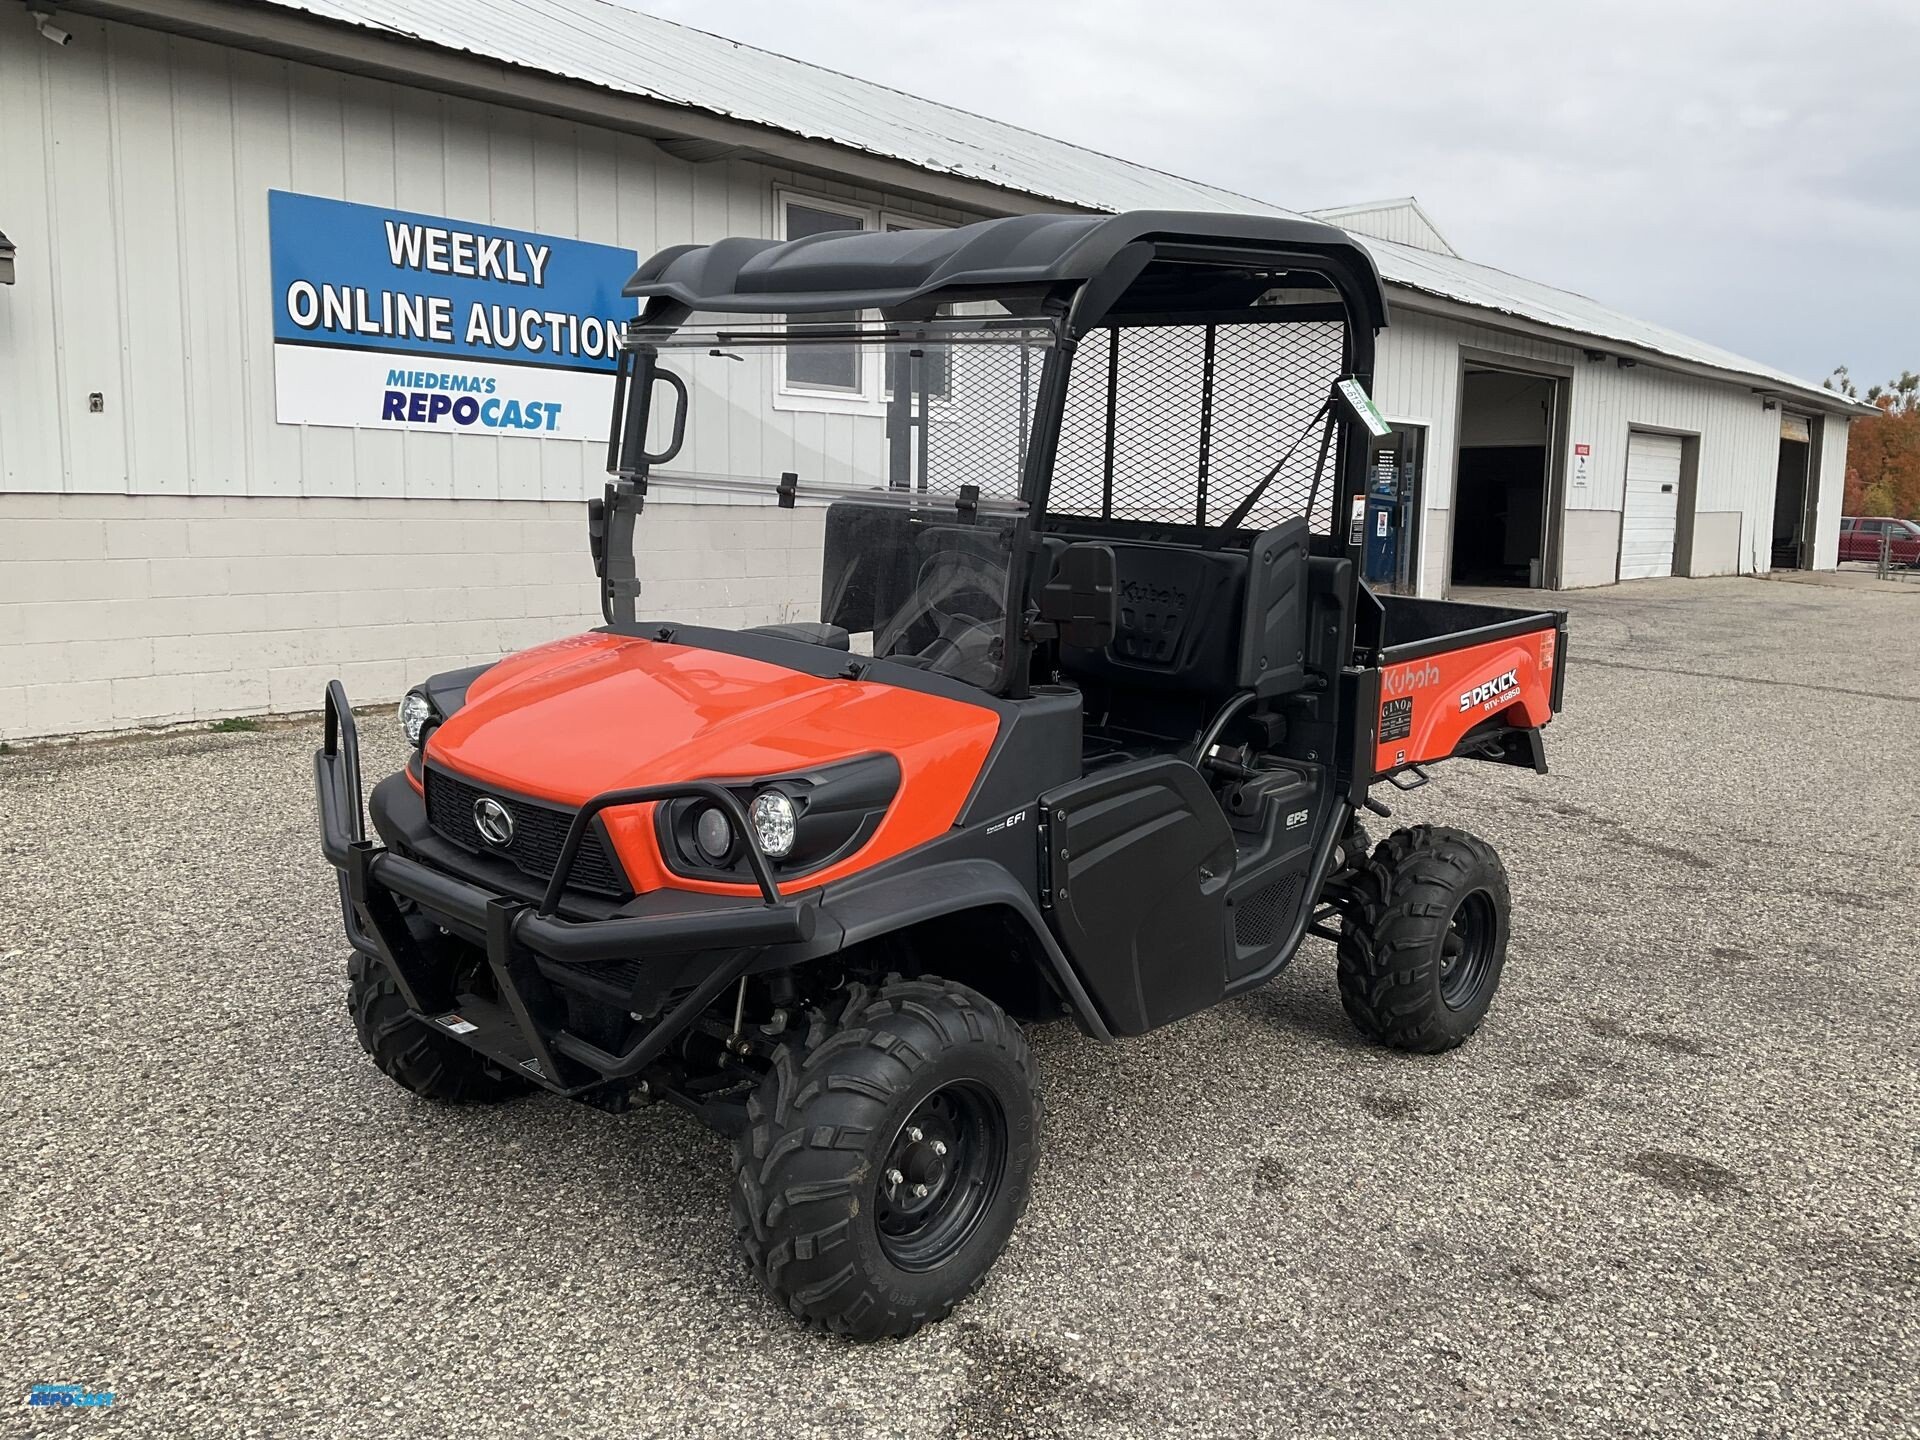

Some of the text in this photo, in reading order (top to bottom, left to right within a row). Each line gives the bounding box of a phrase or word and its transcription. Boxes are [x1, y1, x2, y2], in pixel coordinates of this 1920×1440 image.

[384, 219, 551, 288] WEEKLY
[286, 279, 628, 359] ONLINE AUCTION
[385, 369, 496, 394] MIEDEMA'S
[381, 390, 562, 431] REPOCAST
[1383, 661, 1439, 696] Kubota
[1006, 810, 1026, 827] EFI
[1286, 809, 1309, 826] EPS
